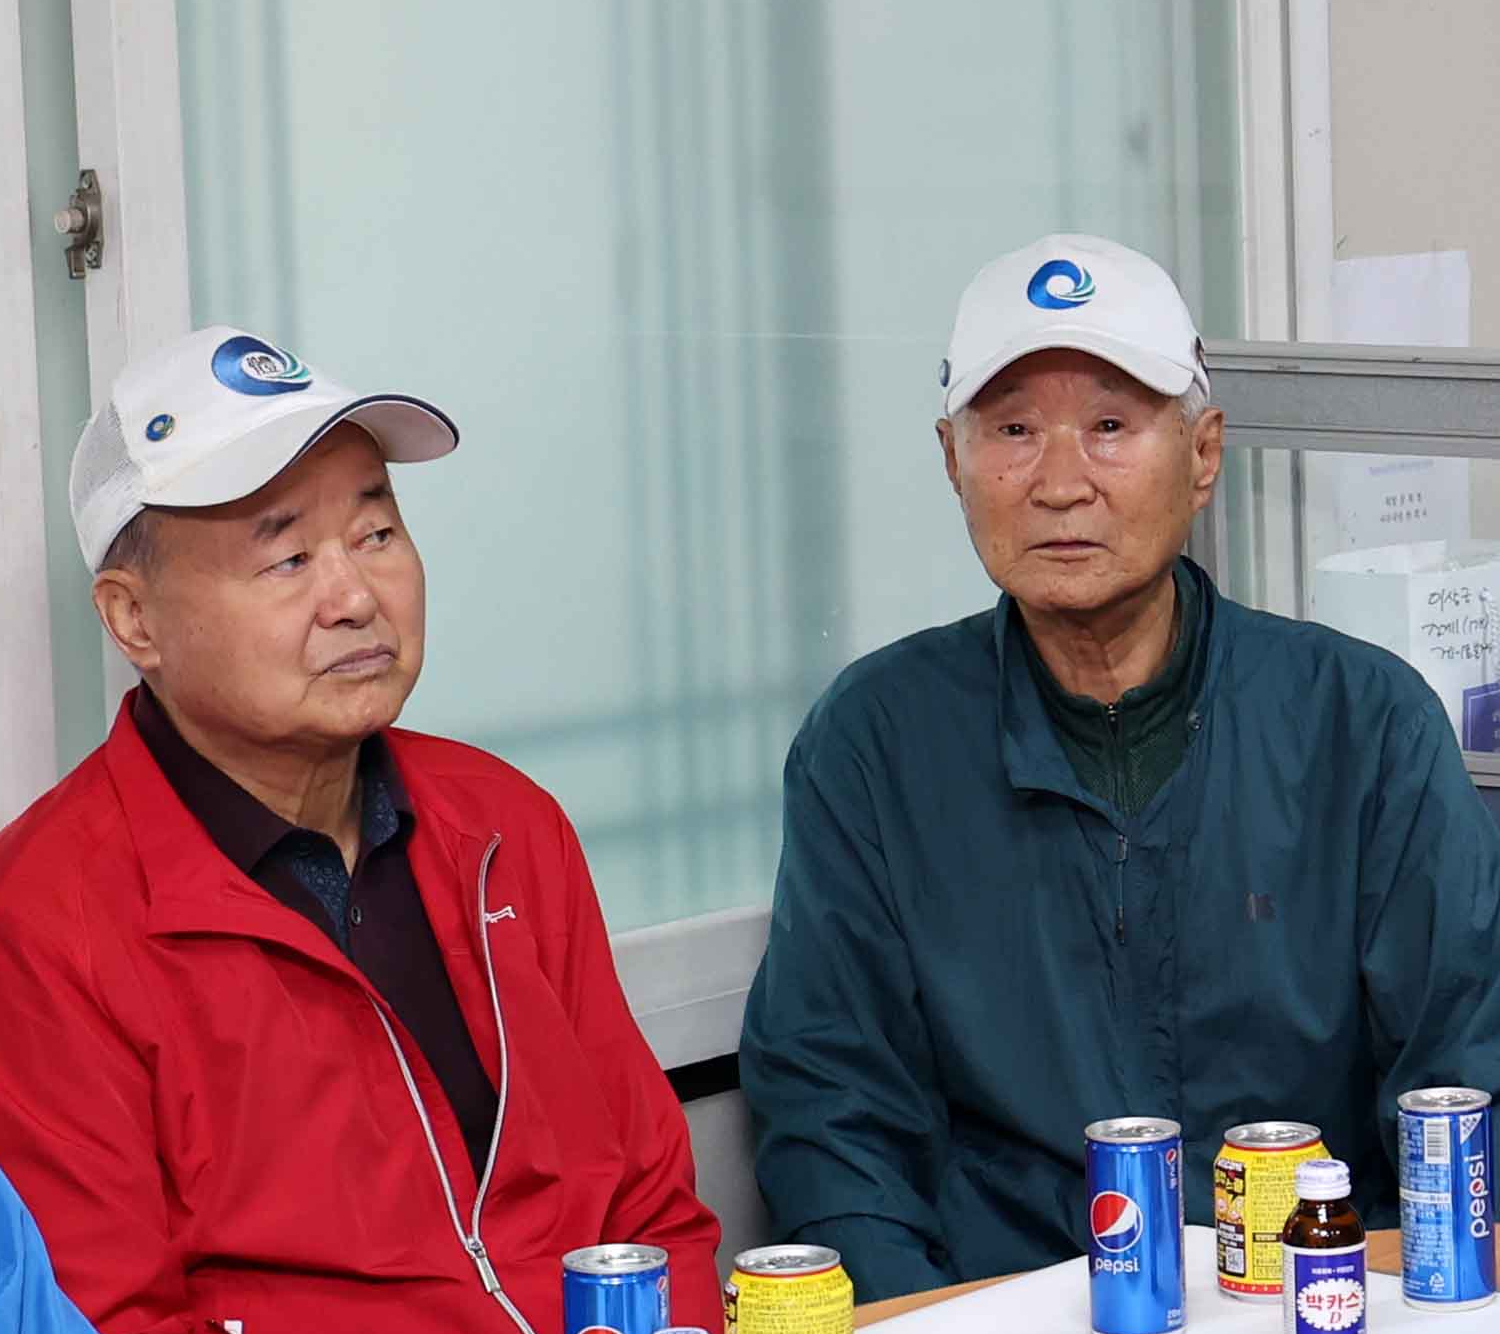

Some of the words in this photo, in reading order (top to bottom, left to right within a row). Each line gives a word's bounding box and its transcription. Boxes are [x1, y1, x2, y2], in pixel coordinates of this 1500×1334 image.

[1463, 1151, 1490, 1238] pepsi
[1096, 1257, 1140, 1274] pepsi
[1305, 1293, 1360, 1309] 박카스
[1330, 1311, 1341, 1324] D
